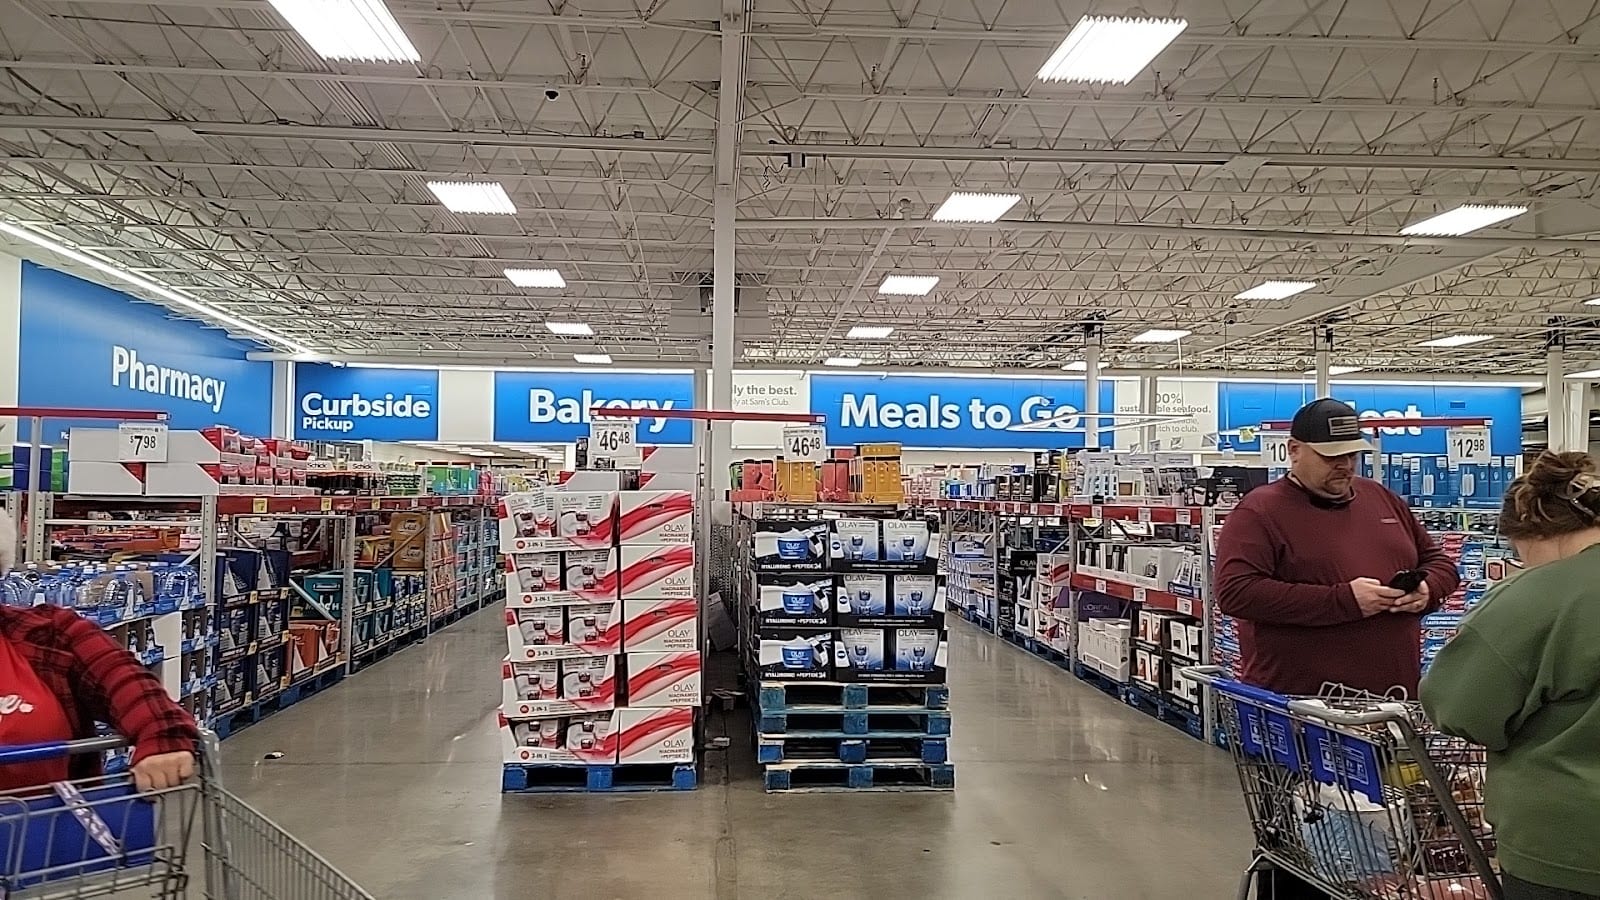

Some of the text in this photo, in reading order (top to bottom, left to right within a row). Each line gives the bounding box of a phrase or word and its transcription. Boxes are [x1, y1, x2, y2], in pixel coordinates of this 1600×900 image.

[112, 345, 226, 413] Pharmacy
[746, 385, 766, 395] the
[768, 385, 797, 396] best.
[301, 392, 431, 418] Curbside
[529, 388, 674, 433] Bakery
[840, 393, 1079, 430] Meals to Go
[1348, 401, 1422, 436] eat
[302, 416, 354, 432] Pickup
[352, 462, 373, 470] Schick
[664, 523, 686, 532] OLAY
[664, 577, 688, 585] OLAY
[895, 575, 917, 583] OLAY
[668, 629, 691, 638] OLAY
[672, 683, 696, 692] OLAY
[663, 739, 686, 748] OLAY
